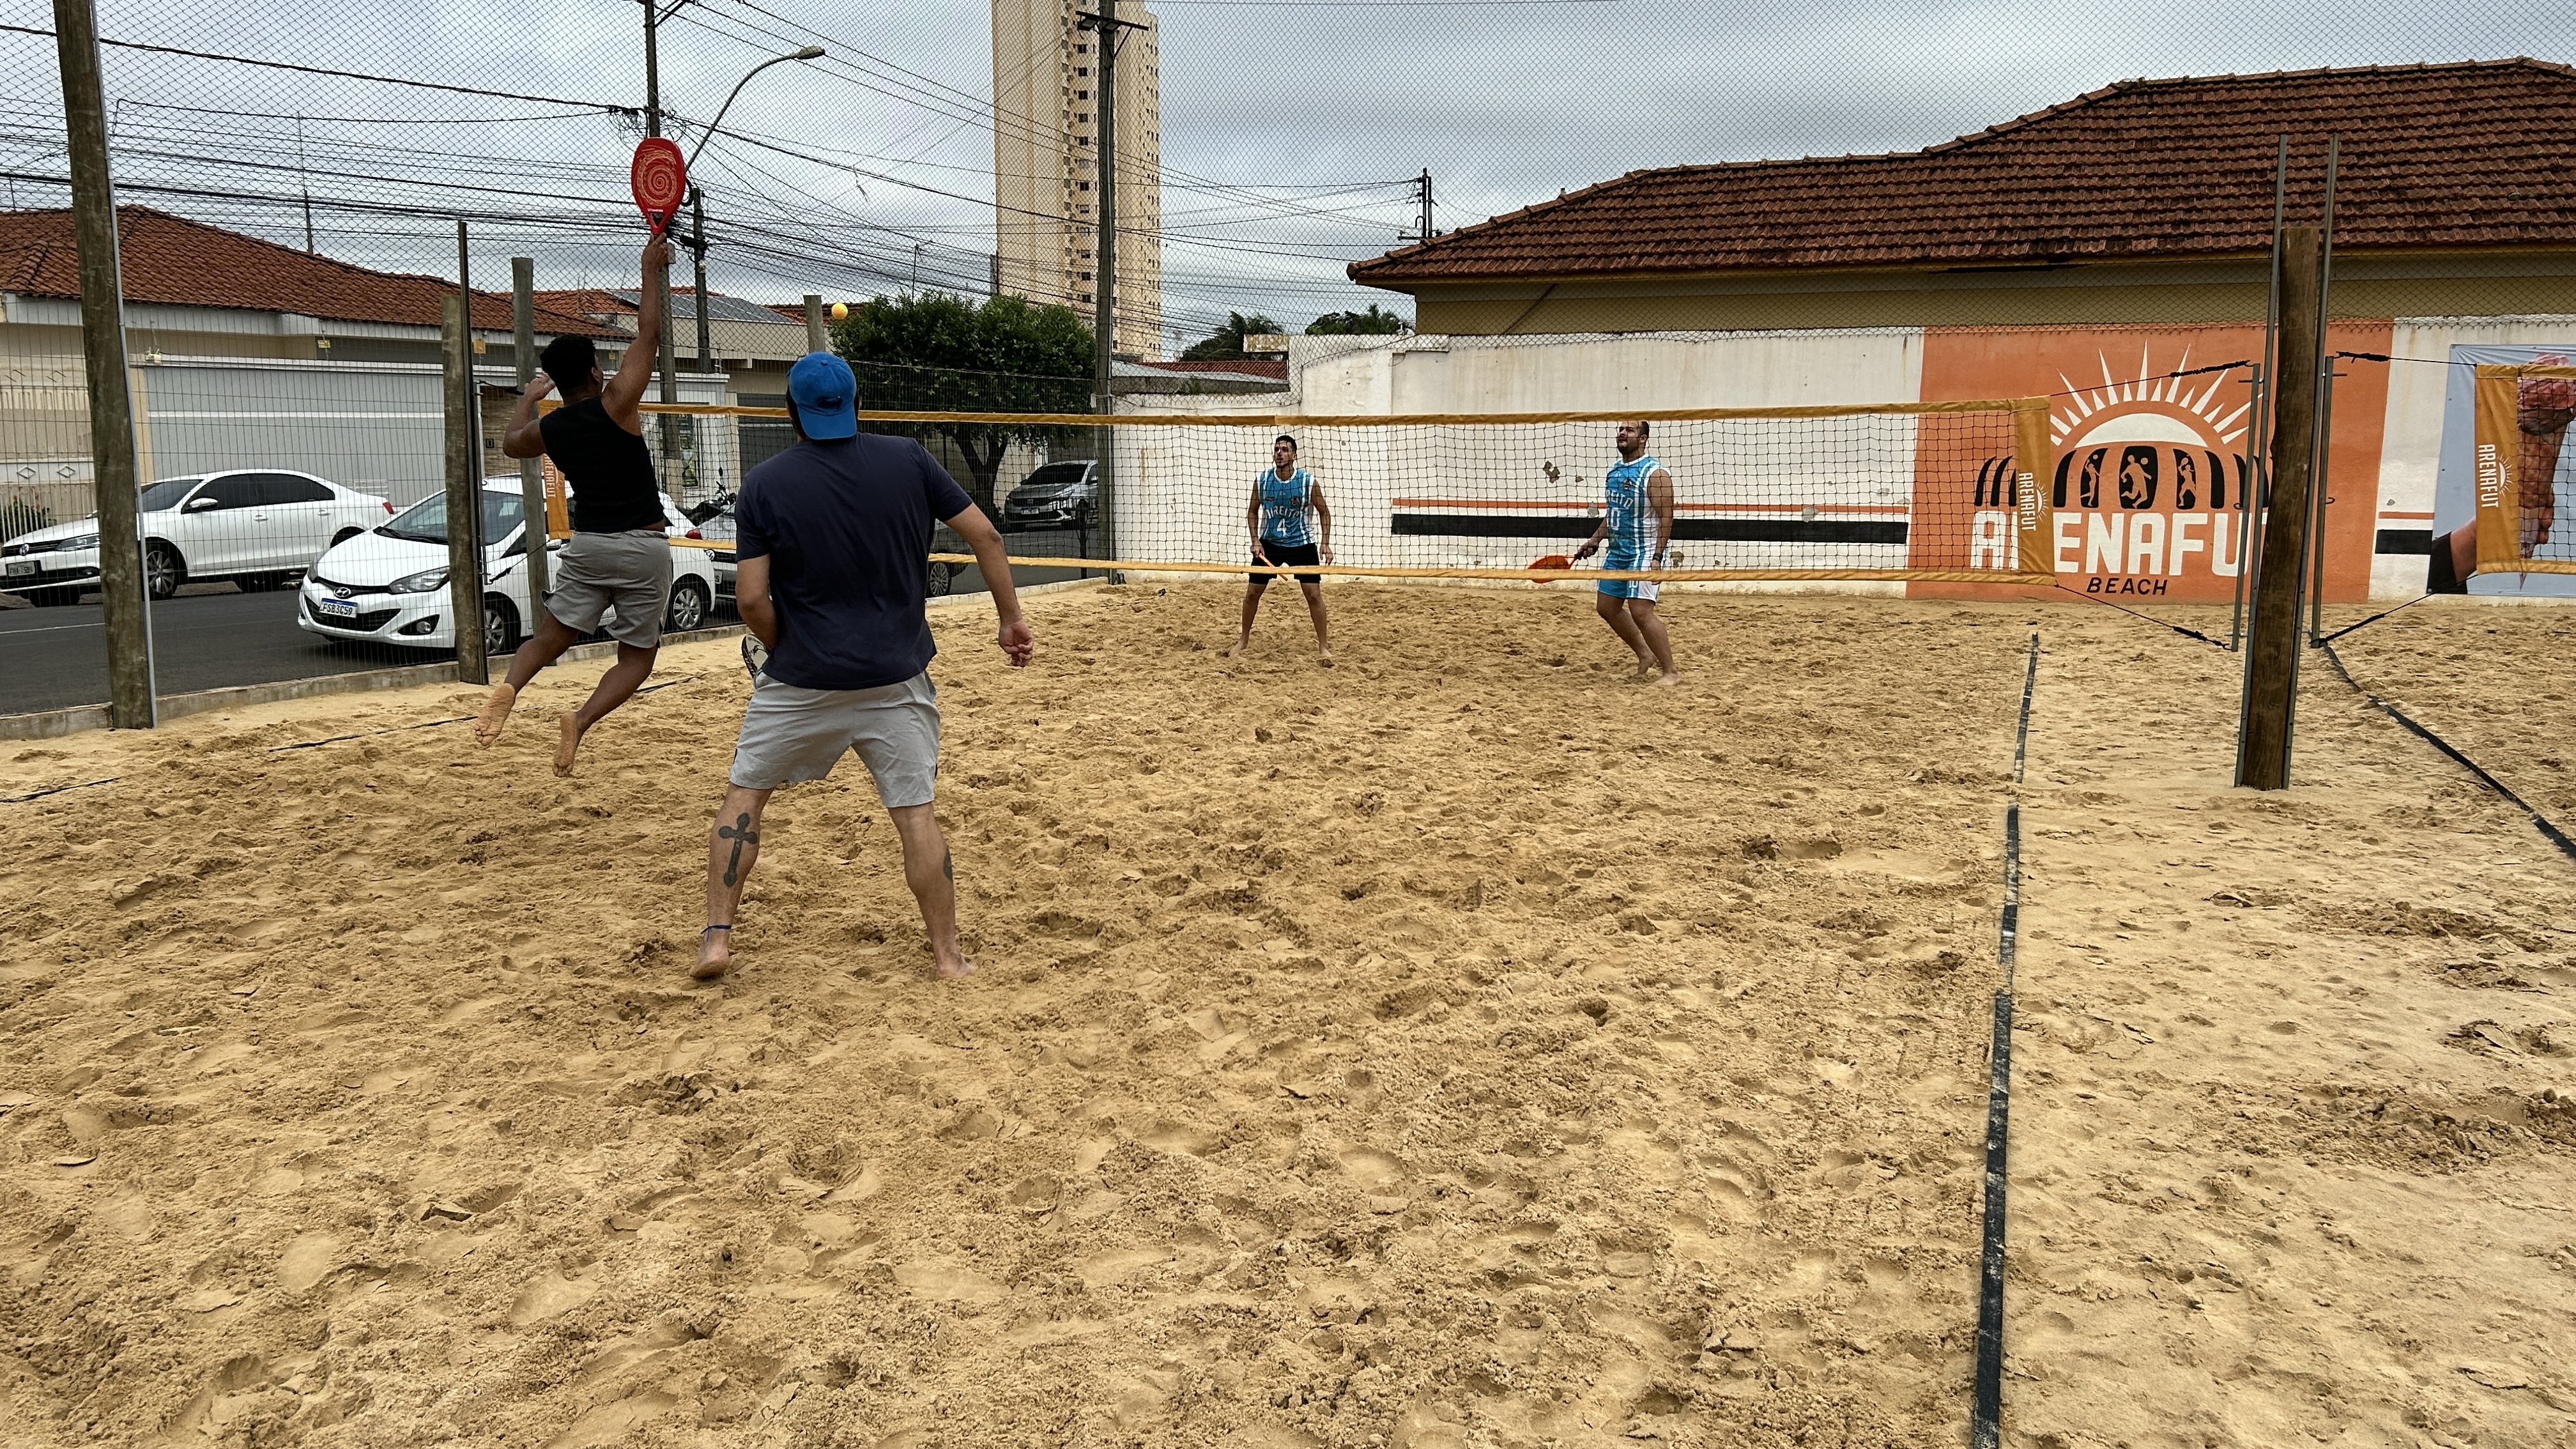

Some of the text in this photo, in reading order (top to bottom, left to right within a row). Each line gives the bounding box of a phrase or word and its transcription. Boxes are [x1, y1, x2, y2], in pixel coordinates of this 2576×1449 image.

[2478, 443, 2499, 507] ARENAFUT
[2019, 472, 2036, 531] ARENAFUT
[1276, 518, 1287, 537] 4
[1970, 510, 2268, 577] AENAFU
[2086, 577, 2168, 595] BEACH
[323, 603, 353, 615] FSB3C59
